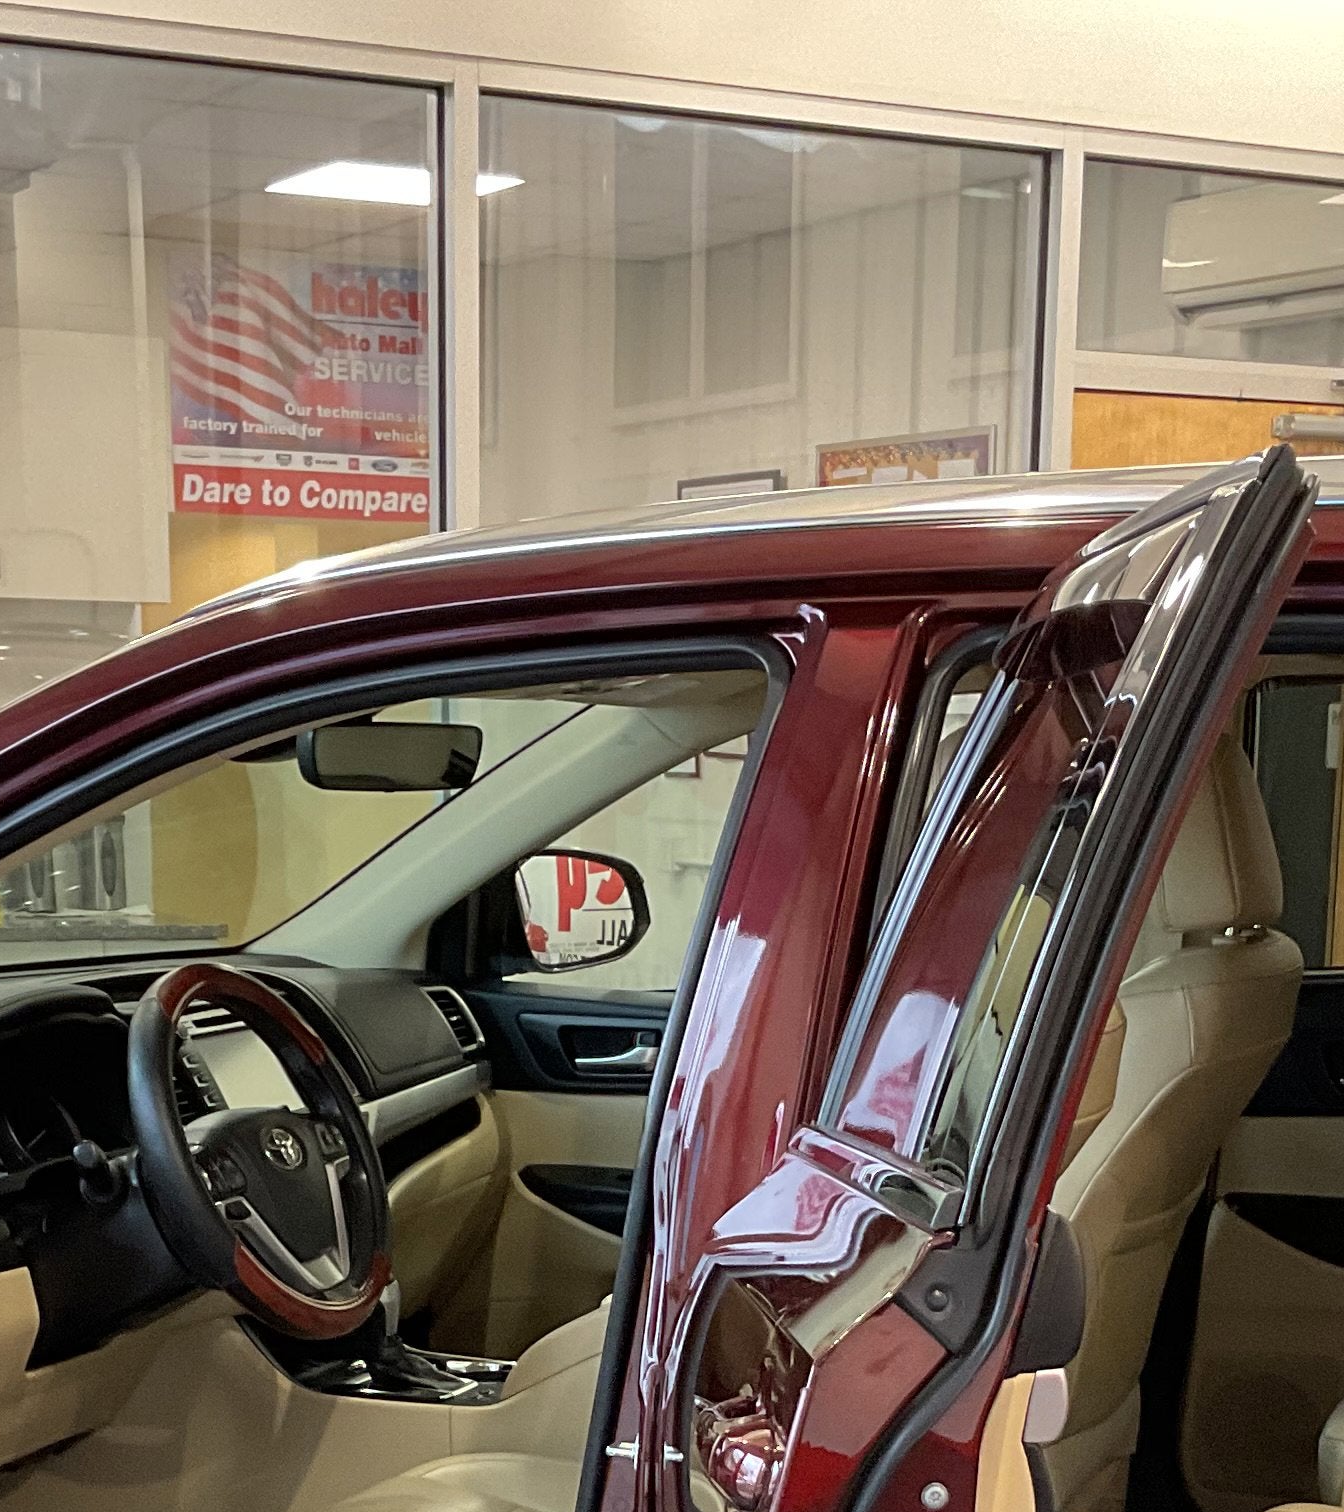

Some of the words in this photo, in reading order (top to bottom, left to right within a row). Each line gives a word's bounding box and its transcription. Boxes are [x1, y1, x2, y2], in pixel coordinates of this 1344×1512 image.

[311, 272, 429, 334] haley
[314, 357, 429, 386] SERVICE
[284, 402, 312, 417] Our
[317, 404, 403, 422] technicians
[183, 416, 237, 436] factory
[242, 419, 297, 437] trained
[301, 423, 324, 438] for
[182, 473, 251, 505] Dare
[261, 478, 291, 507] to
